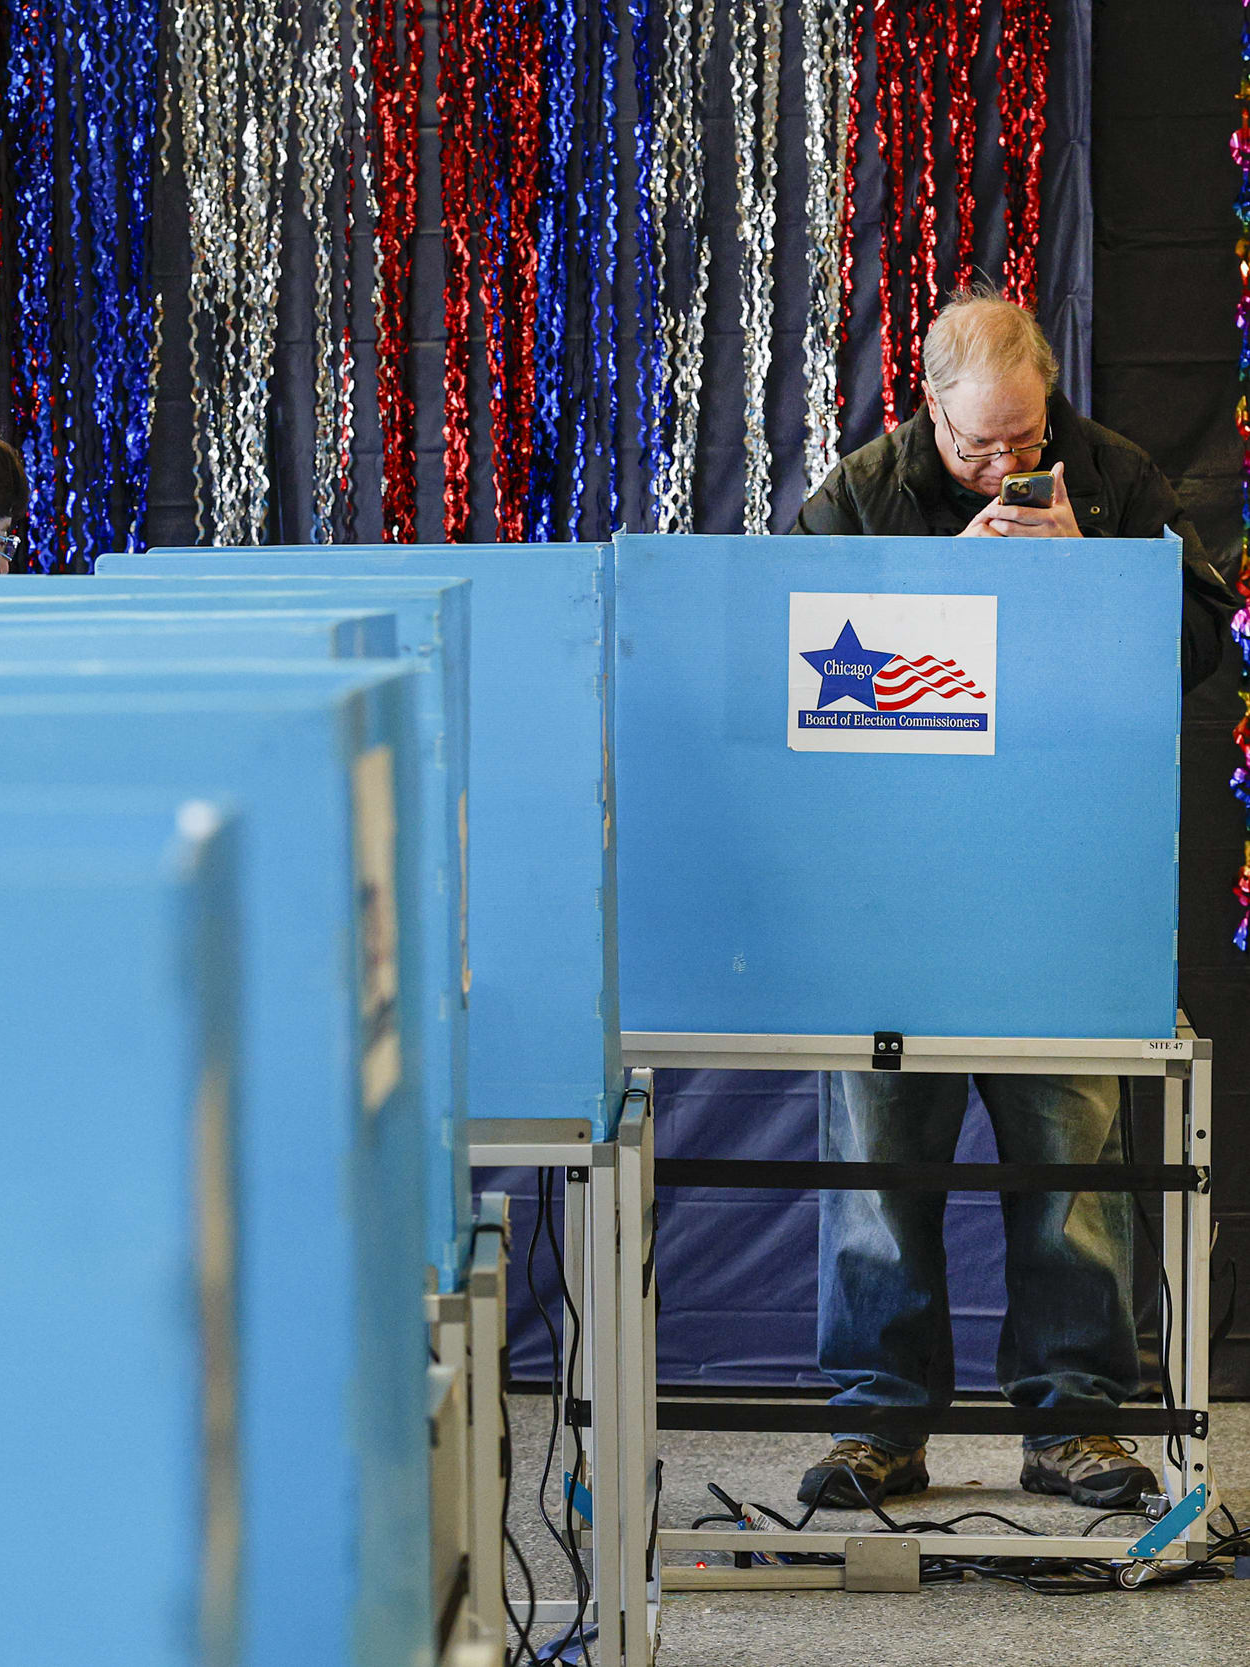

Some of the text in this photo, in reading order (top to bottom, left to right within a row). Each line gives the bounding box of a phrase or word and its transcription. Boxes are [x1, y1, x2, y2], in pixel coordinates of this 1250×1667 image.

[823, 659, 873, 680] Chicago
[805, 713, 980, 728] Board of Election Commissioners
[1150, 1042, 1183, 1050] SITE 47
